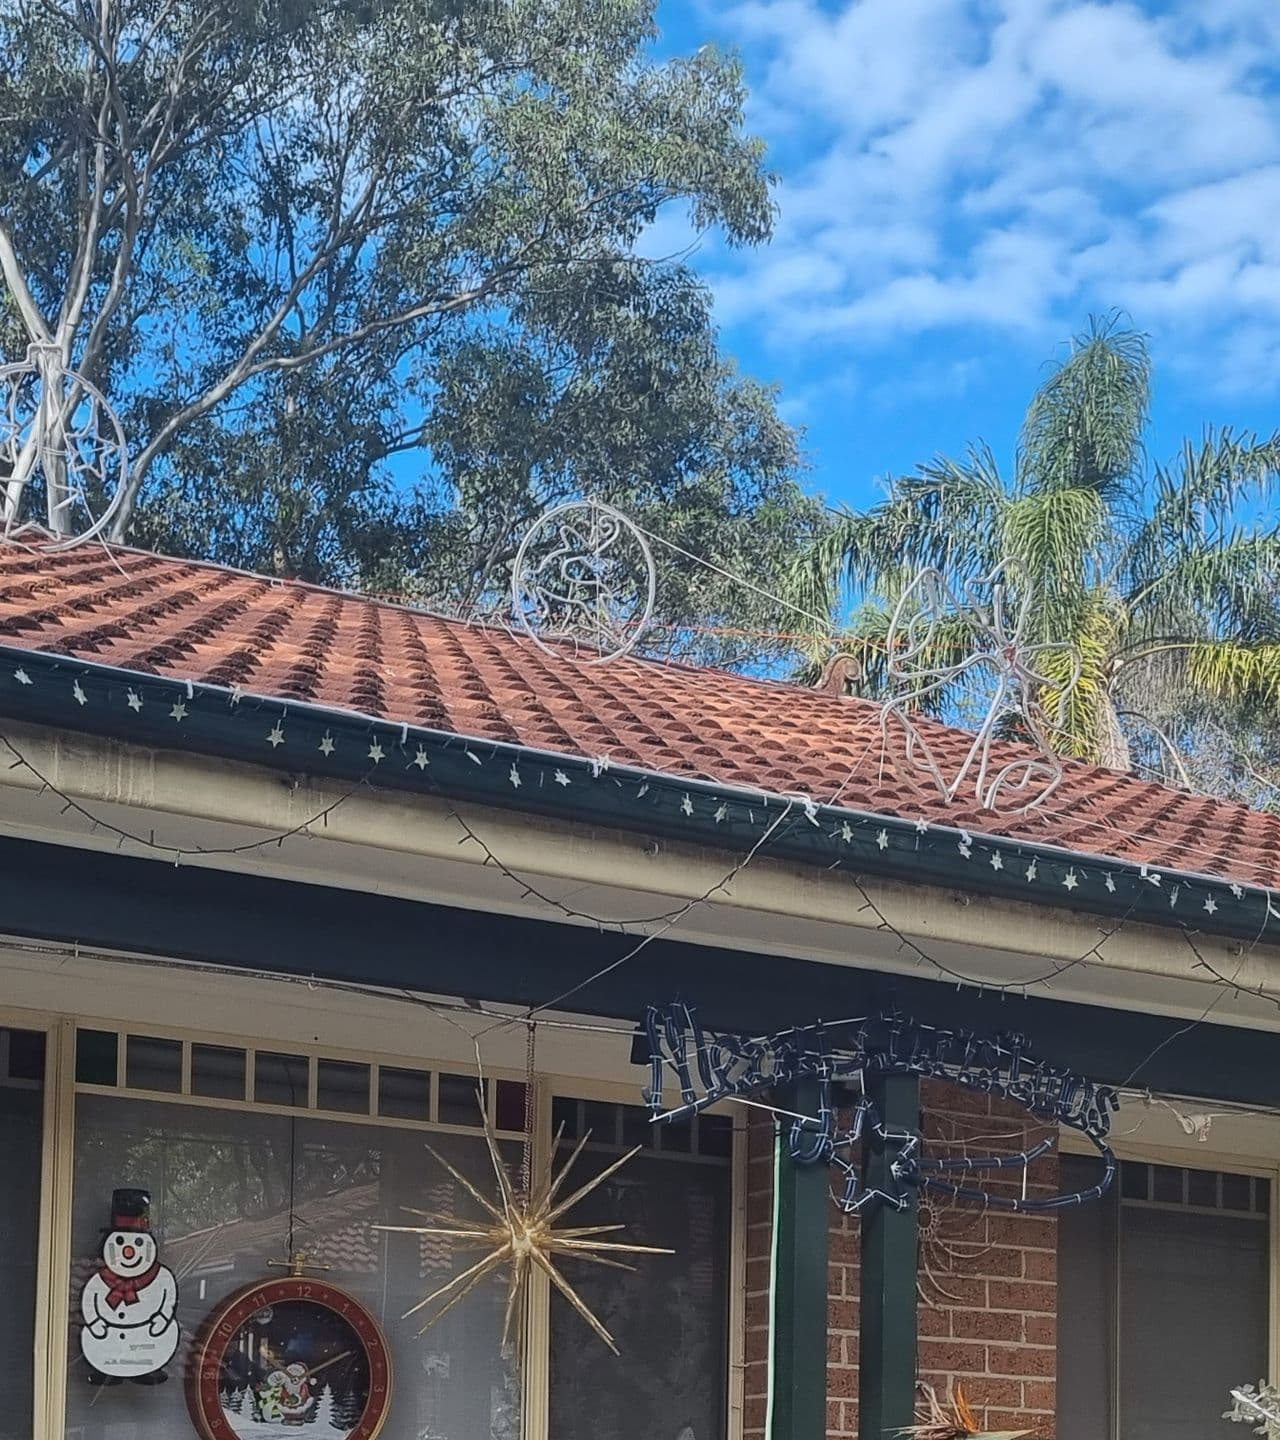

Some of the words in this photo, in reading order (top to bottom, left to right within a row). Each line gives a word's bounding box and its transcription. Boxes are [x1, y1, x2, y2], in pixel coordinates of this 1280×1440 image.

[296, 1286, 312, 1298] 12
[252, 1293, 267, 1307] 11
[342, 1303, 350, 1313] 1
[218, 1322, 233, 1339] 10
[368, 1339, 378, 1348] 2
[374, 1385, 385, 1393] 3
[210, 1418, 223, 1429] 8
